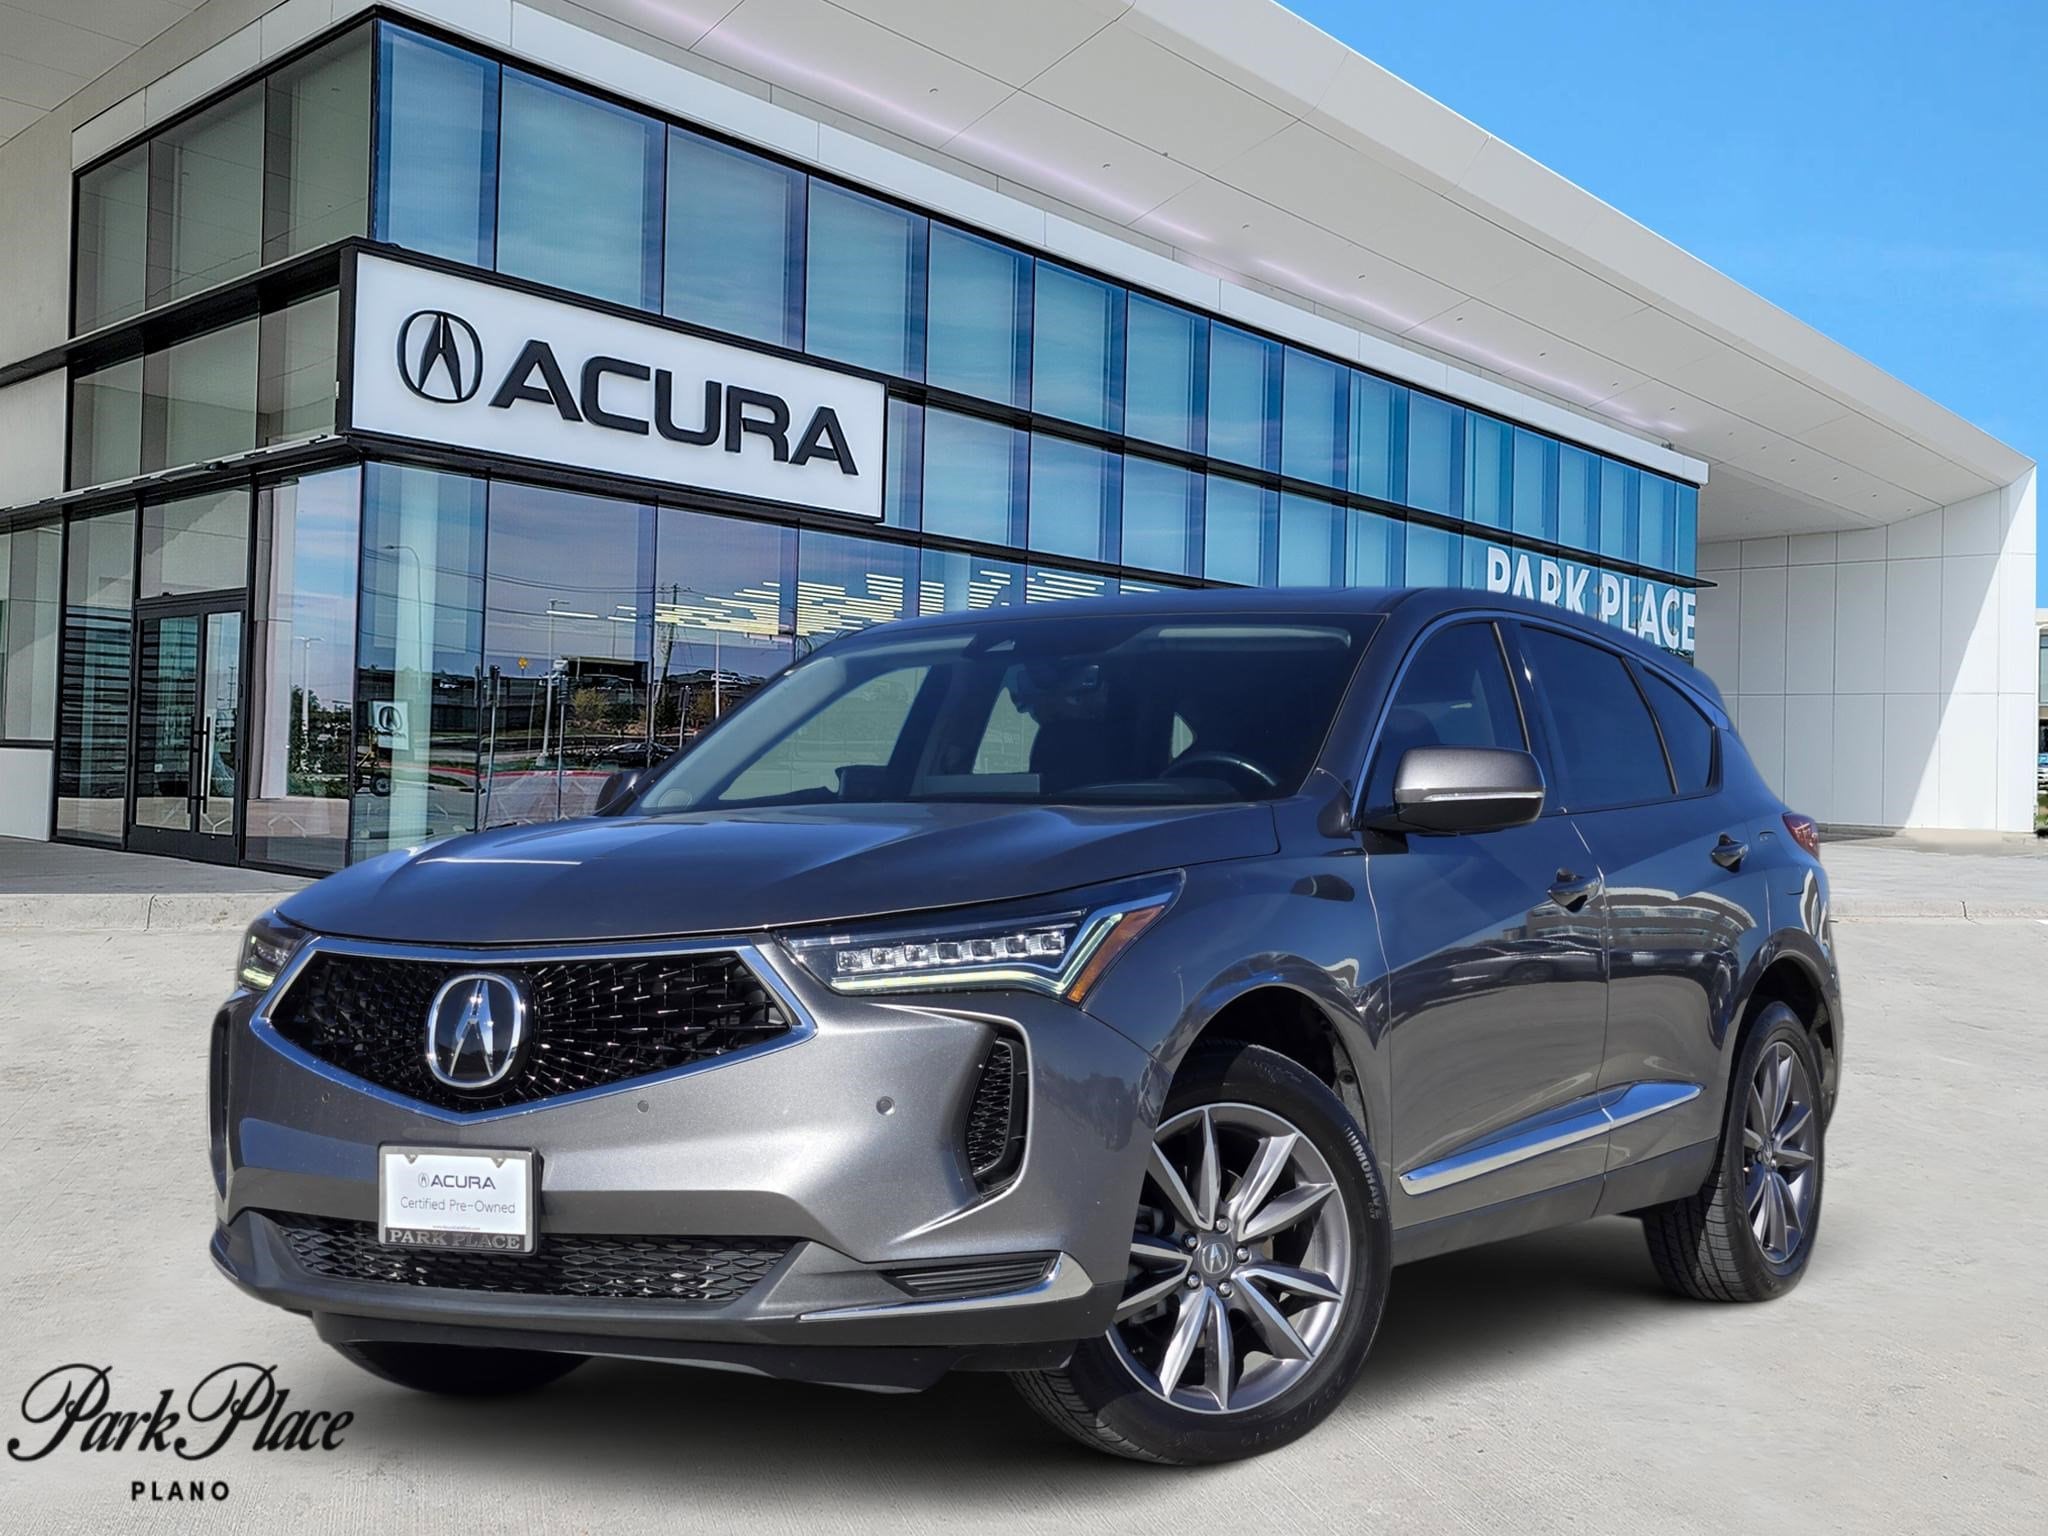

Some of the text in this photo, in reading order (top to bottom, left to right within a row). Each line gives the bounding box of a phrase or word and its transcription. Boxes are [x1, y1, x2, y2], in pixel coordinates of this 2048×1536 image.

[488, 339, 859, 476] ACURA
[1487, 546, 1696, 651] PARK PLACE
[430, 1174, 496, 1190] ACURA
[400, 1196, 516, 1214] Certified Pre-Owned
[389, 1229, 520, 1249] PARK PLACE
